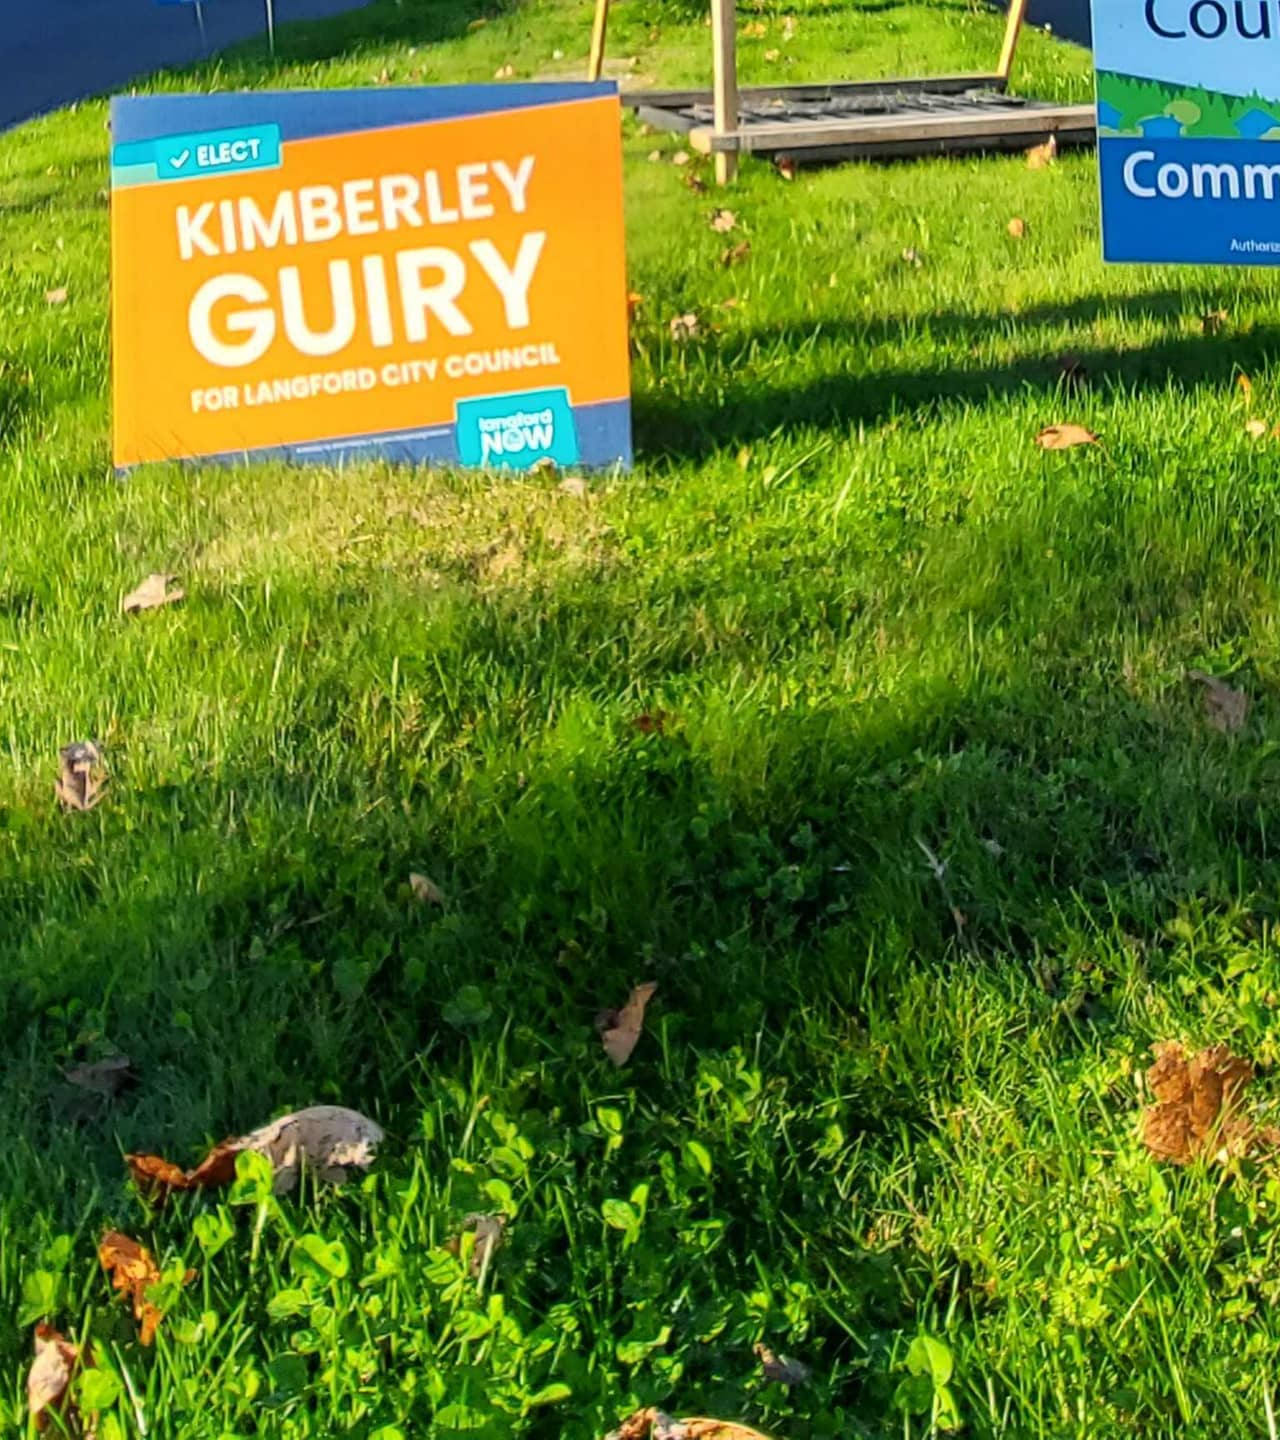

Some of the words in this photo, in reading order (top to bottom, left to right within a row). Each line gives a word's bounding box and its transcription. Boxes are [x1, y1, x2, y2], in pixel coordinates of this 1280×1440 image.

[197, 139, 261, 164] ELECT
[176, 156, 536, 260] KIMBERLEY
[188, 232, 546, 367] GUIRY
[191, 387, 238, 412] FOR
[243, 368, 376, 406] LANGFORD
[381, 358, 437, 387] CITY
[444, 343, 560, 376] COUNCIL
[480, 424, 553, 455] NOW
